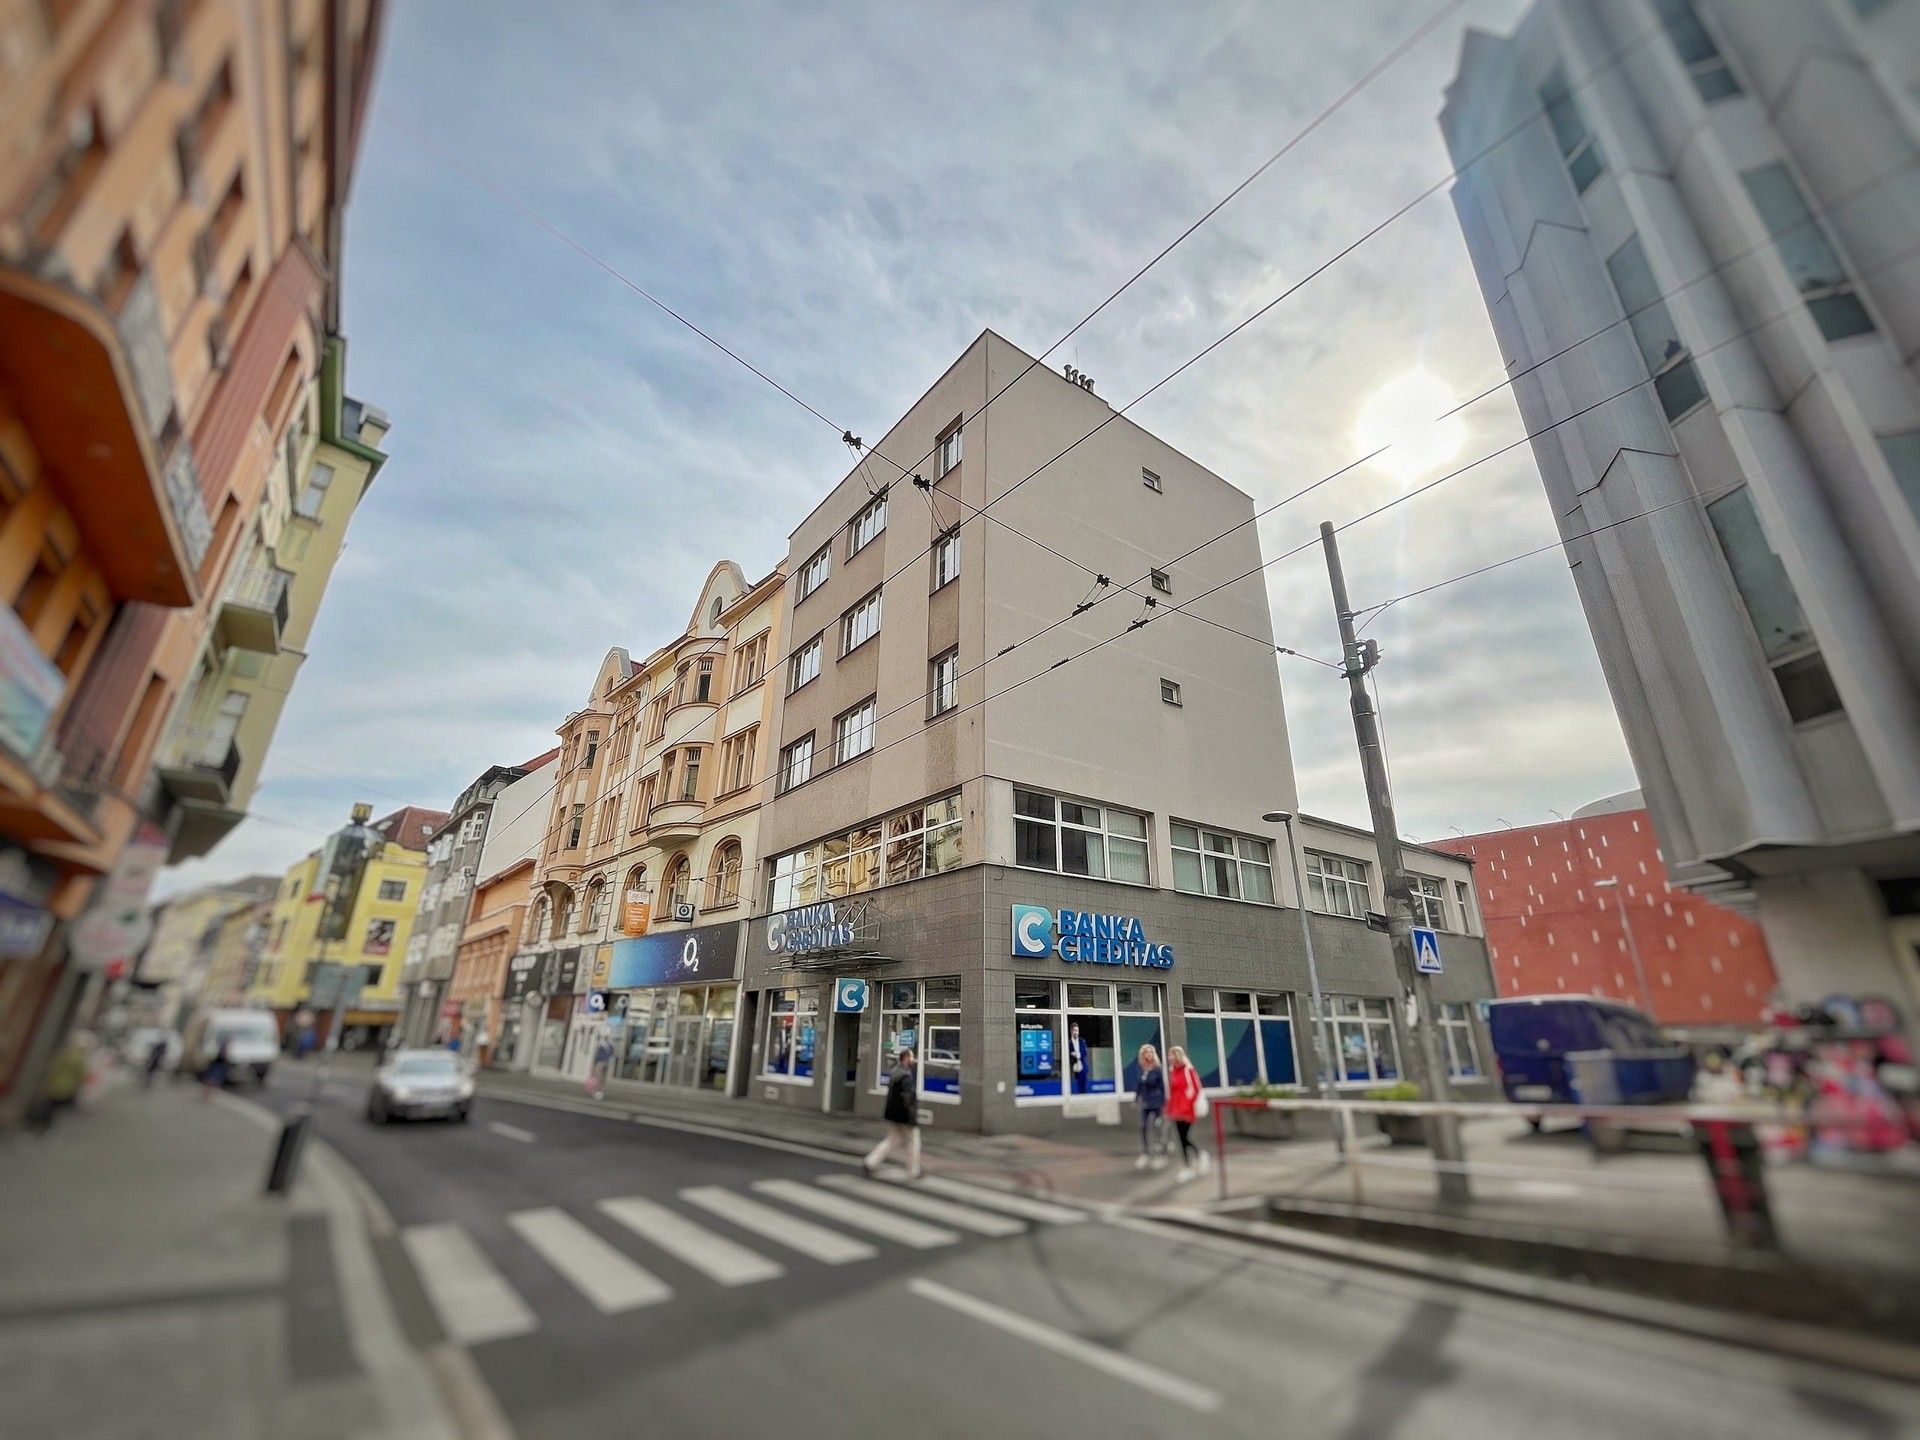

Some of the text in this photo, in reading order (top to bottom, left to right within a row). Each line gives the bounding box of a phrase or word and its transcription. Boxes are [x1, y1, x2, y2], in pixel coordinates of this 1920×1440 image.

[787, 903, 836, 928] BANKA
[1058, 909, 1145, 942] BANKA
[1057, 935, 1174, 969] CREDITAS
